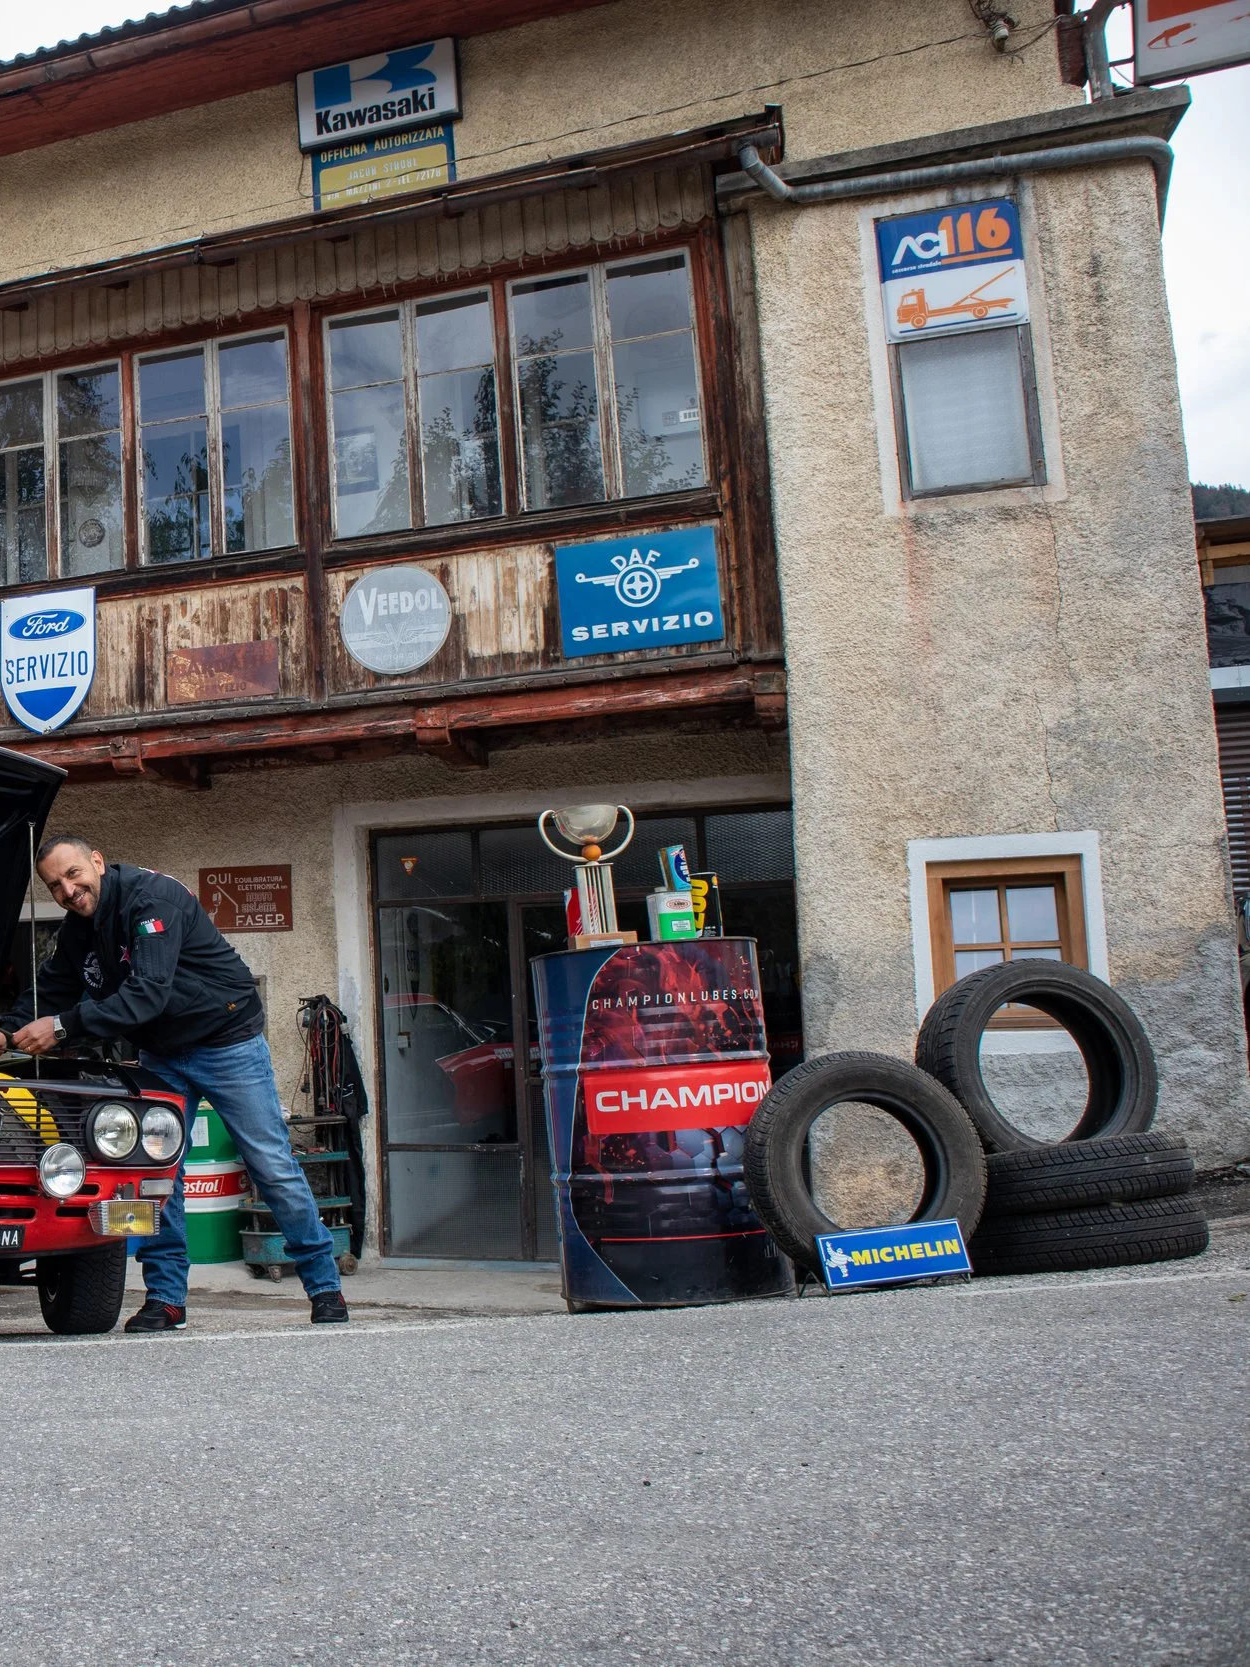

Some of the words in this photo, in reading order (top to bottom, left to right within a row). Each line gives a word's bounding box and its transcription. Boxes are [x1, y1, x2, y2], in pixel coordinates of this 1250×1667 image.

[315, 87, 436, 136] Kawasaki
[320, 143, 367, 164] OFFICINA
[373, 125, 445, 152] AUTORIZZATA
[937, 207, 1011, 254] 116
[610, 548, 661, 572] DAF
[357, 587, 443, 626] VEEDOL
[22, 613, 71, 637] Ford
[571, 611, 714, 642] SERVIZIO
[5, 650, 89, 685] SERVIZIO
[206, 872, 232, 885] QUI
[234, 875, 283, 884] EQUILIBRATURA
[237, 883, 280, 891] ELETTRONICA
[595, 1080, 770, 1113] CHAMPION
[183, 1179, 219, 1194] astrol
[1, 1230, 19, 1246] NA
[852, 1238, 961, 1266] MICHELIN
